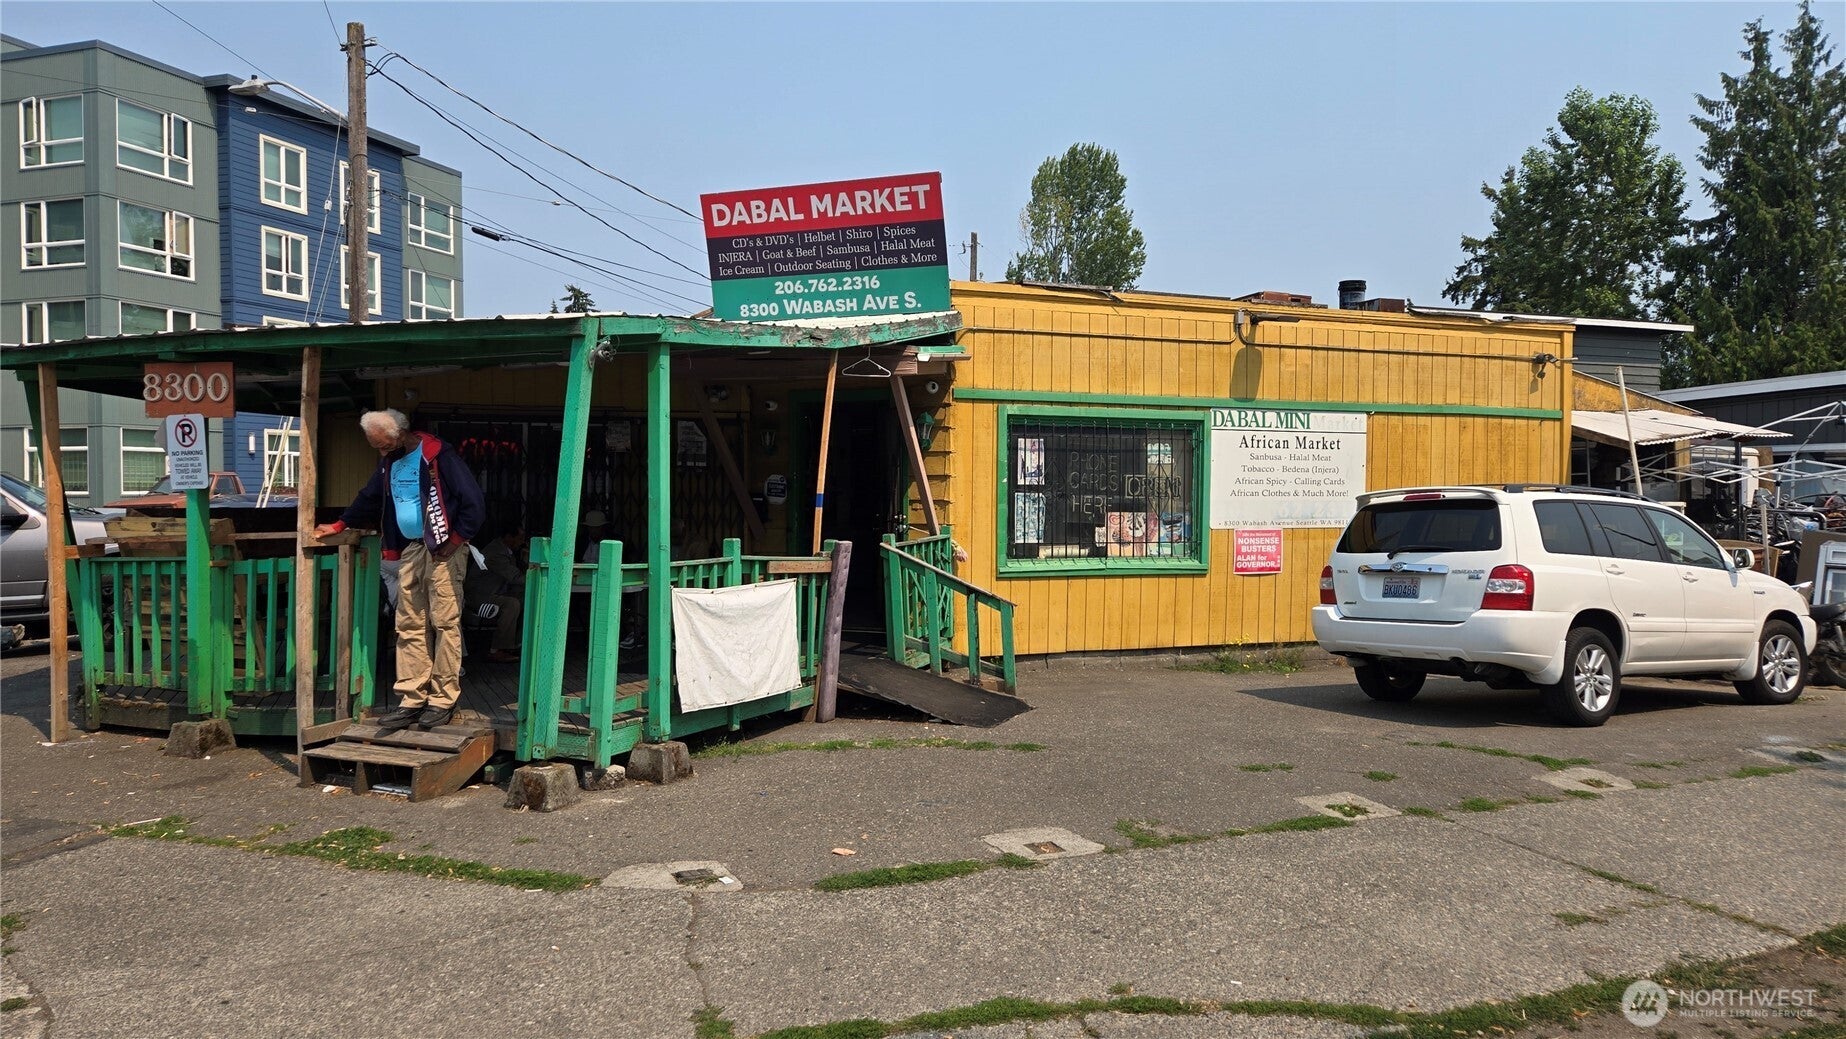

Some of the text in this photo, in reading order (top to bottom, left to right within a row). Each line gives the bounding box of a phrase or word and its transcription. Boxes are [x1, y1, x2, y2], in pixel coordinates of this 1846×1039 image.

[711, 184, 931, 227] DABAL MARKET
[732, 238, 754, 248] CD's
[756, 238, 763, 247] &
[765, 235, 794, 246] DVD's
[804, 232, 836, 243] Helbet
[846, 229, 873, 240] Shiro
[883, 226, 916, 239] Spices
[718, 251, 753, 264] INJERA
[762, 250, 784, 260] Goat
[786, 249, 793, 258] &
[795, 246, 817, 257] Beef
[827, 244, 870, 255] Sambusa
[881, 239, 907, 251] Halal
[910, 238, 935, 249] Meat
[719, 266, 733, 276] Ice
[735, 265, 765, 275] Cream
[774, 261, 813, 272] Outdoor
[815, 258, 851, 270] Seating
[861, 255, 898, 267] Clothes
[900, 254, 908, 263] &
[911, 253, 938, 263] More
[774, 275, 880, 295] 206.762.2316
[740, 302, 779, 317] 8300
[904, 291, 922, 308] S.
[143, 373, 229, 401] 8300
[1212, 410, 1272, 428] DABAL
[1275, 412, 1311, 429] MINI
[1239, 434, 1341, 450] African Market
[1249, 453, 1282, 461] Sanbusa
[1289, 453, 1310, 461] Halal
[1241, 464, 1275, 473] Tobacco
[1282, 465, 1310, 473] Bedena
[1311, 465, 1340, 475] (Injera)
[1234, 477, 1264, 485] African
[1266, 477, 1287, 487] Spicy
[1294, 477, 1321, 487] Calling
[1230, 489, 1259, 497] African
[1261, 489, 1291, 497] Clothes
[1302, 489, 1324, 497] Much
[1326, 489, 1349, 497] More!
[430, 485, 449, 543] OROMIA
[1237, 537, 1280, 545] NONSENSE
